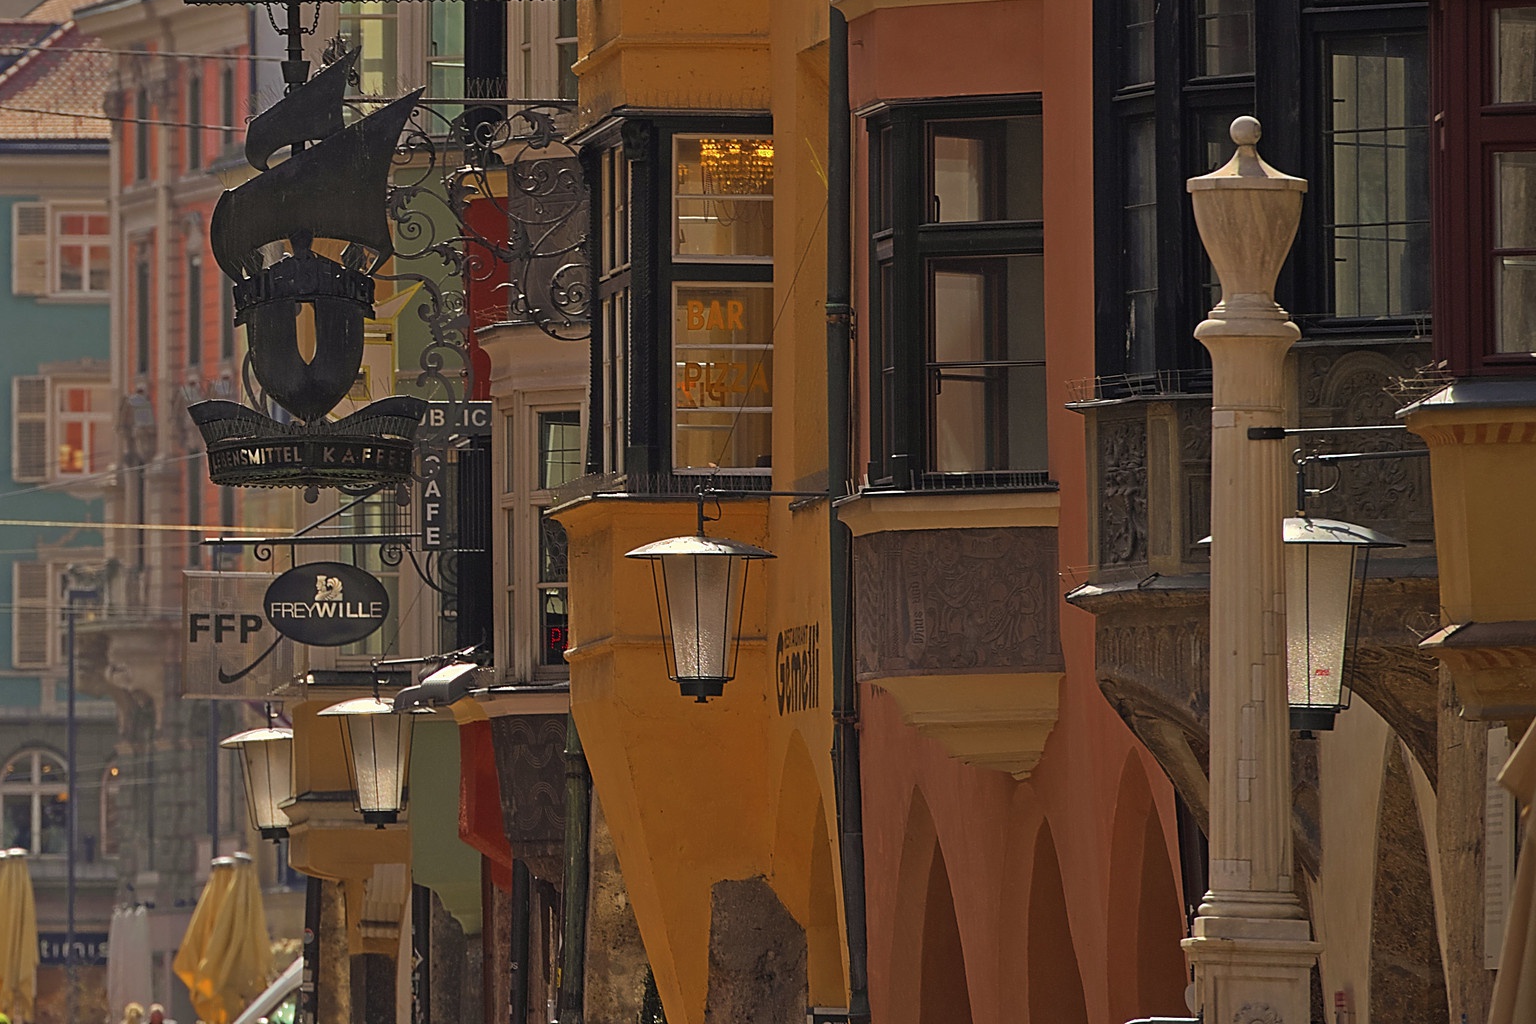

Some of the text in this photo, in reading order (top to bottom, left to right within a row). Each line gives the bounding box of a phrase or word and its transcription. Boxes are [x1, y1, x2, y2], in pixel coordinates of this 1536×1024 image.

[687, 300, 744, 331] BAR
[684, 362, 769, 394] PIZZA
[212, 446, 406, 469] LEBENSMITTEL KAFFEE
[270, 601, 383, 619] FREYWILLE
[189, 613, 263, 644] FFP
[776, 621, 819, 717] Gemelli
